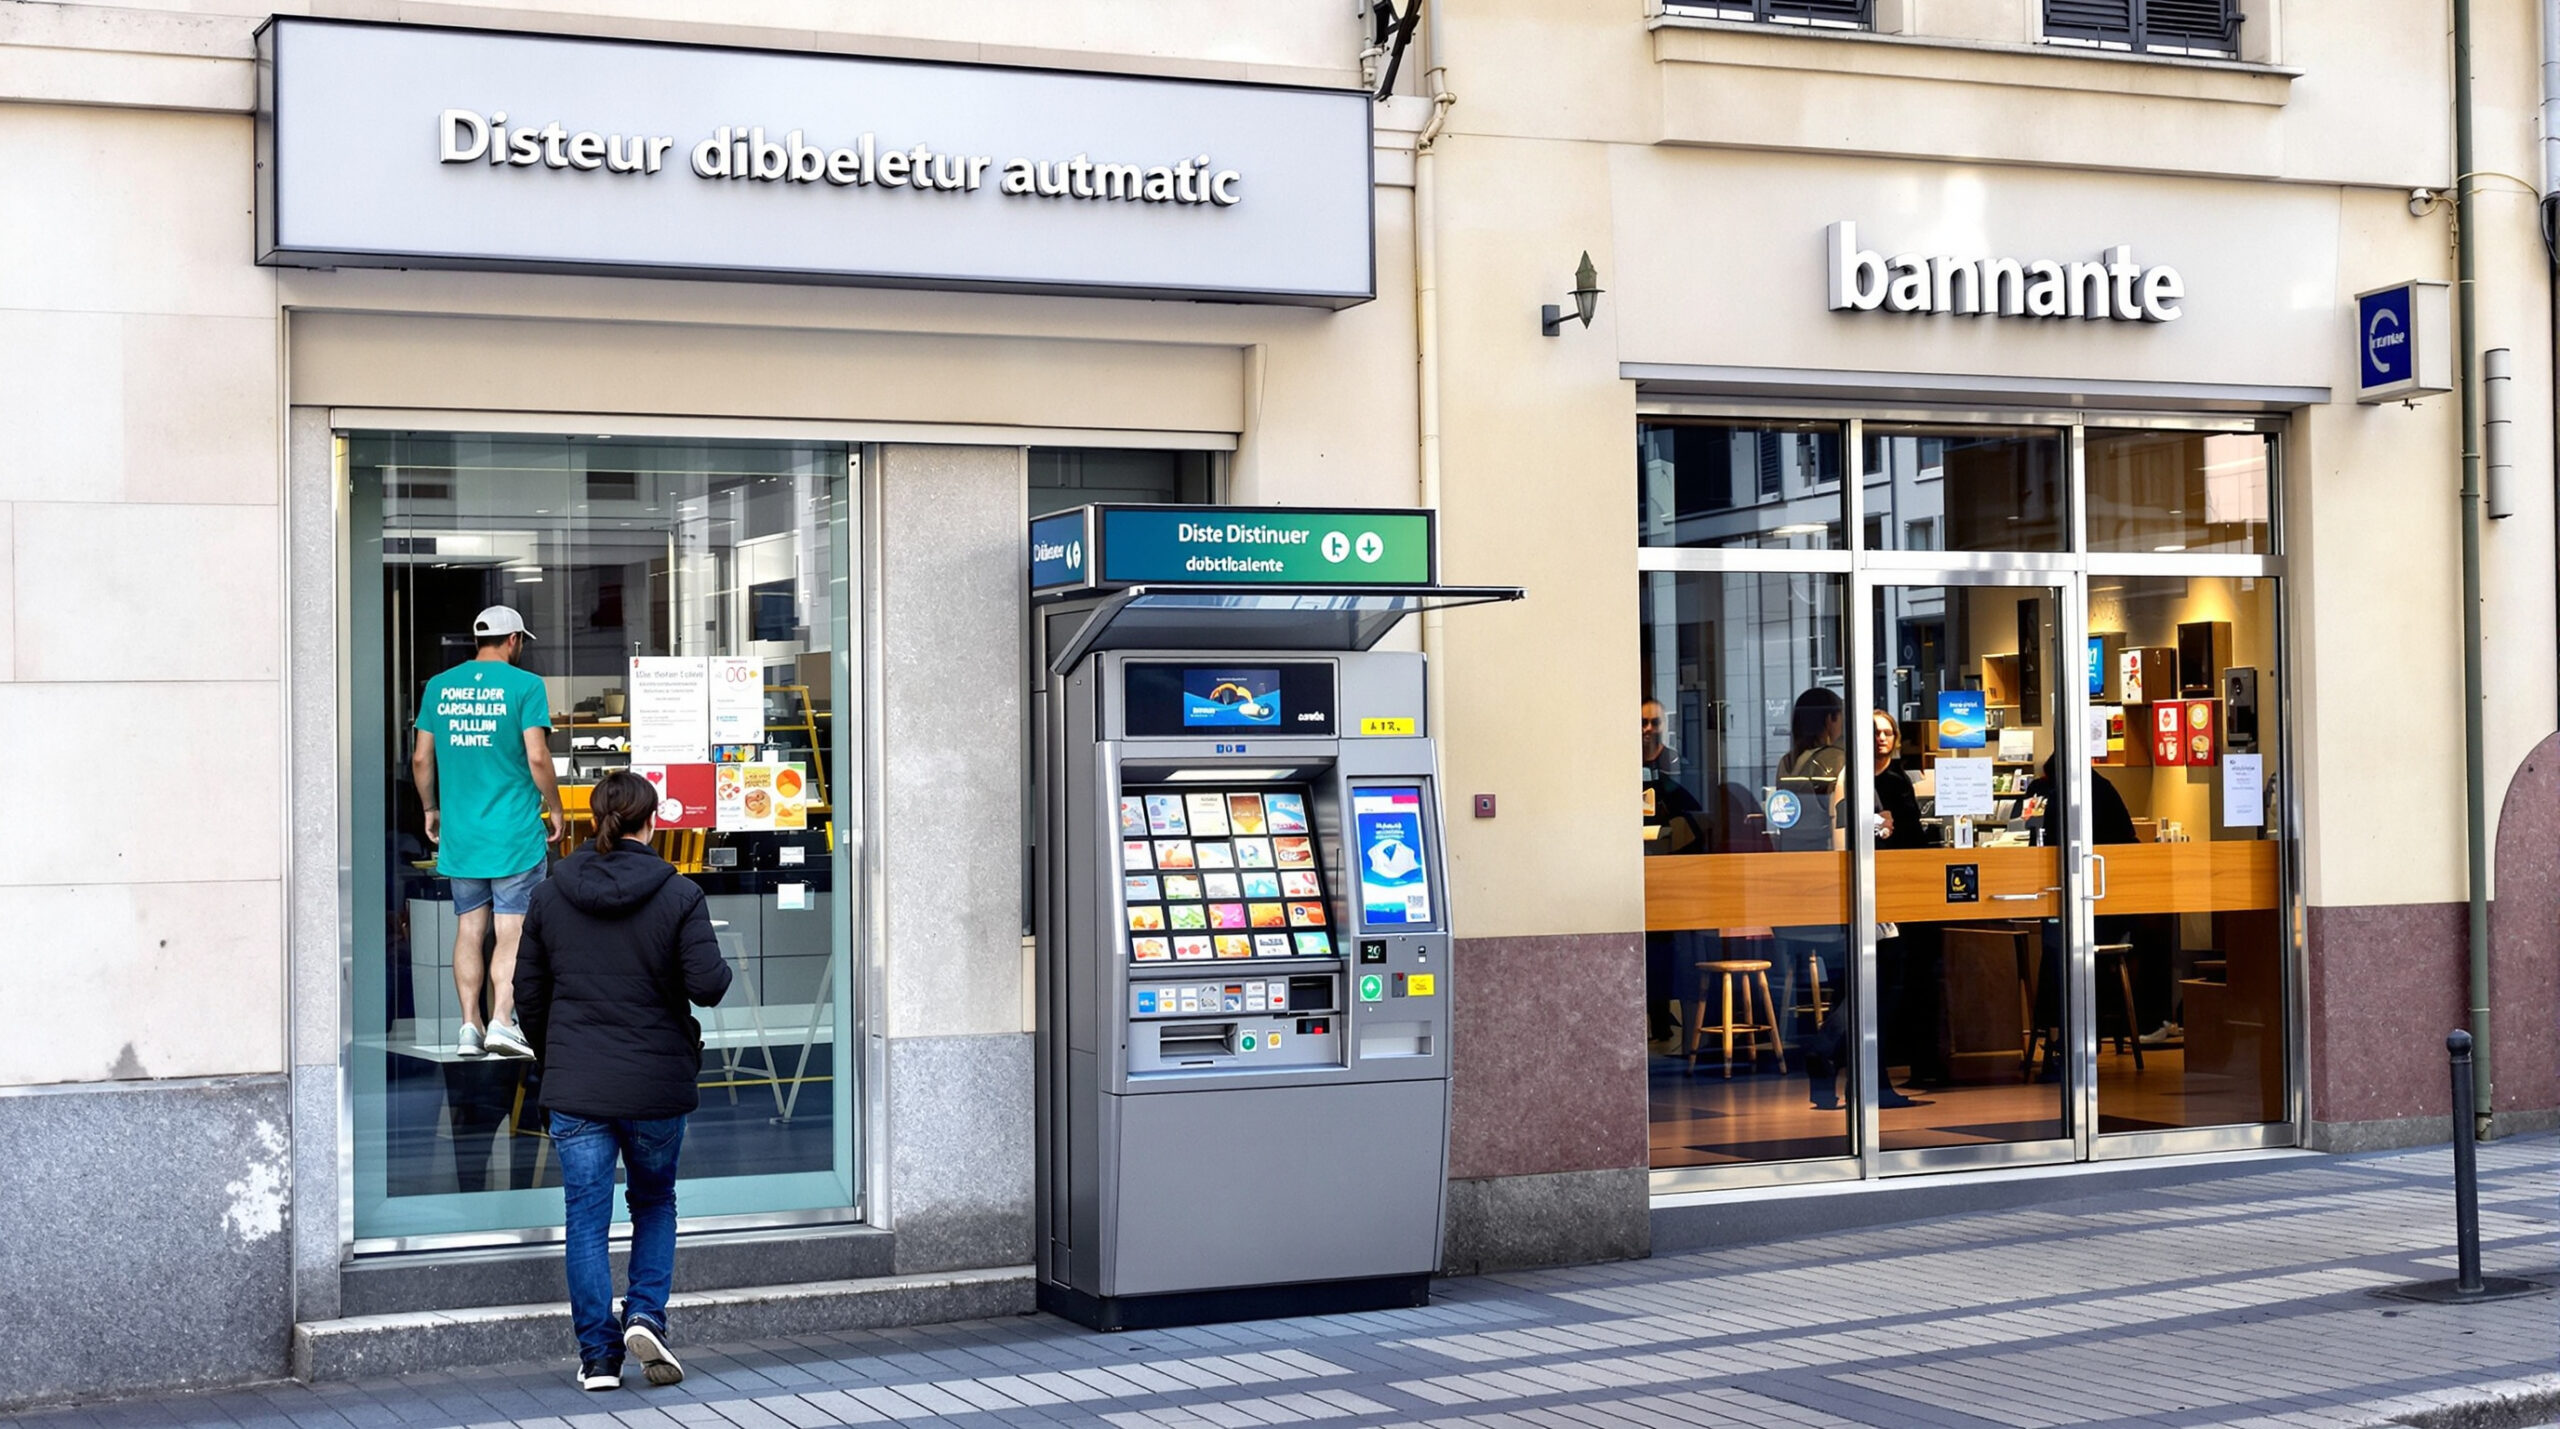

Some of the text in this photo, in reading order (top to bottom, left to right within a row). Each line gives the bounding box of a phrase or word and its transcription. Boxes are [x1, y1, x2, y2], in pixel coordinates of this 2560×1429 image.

[438, 107, 1241, 206] Disteur dibbeletur autmatic
[1826, 220, 2185, 322] bannante
[1178, 523, 1310, 545] Diste Distinuer
